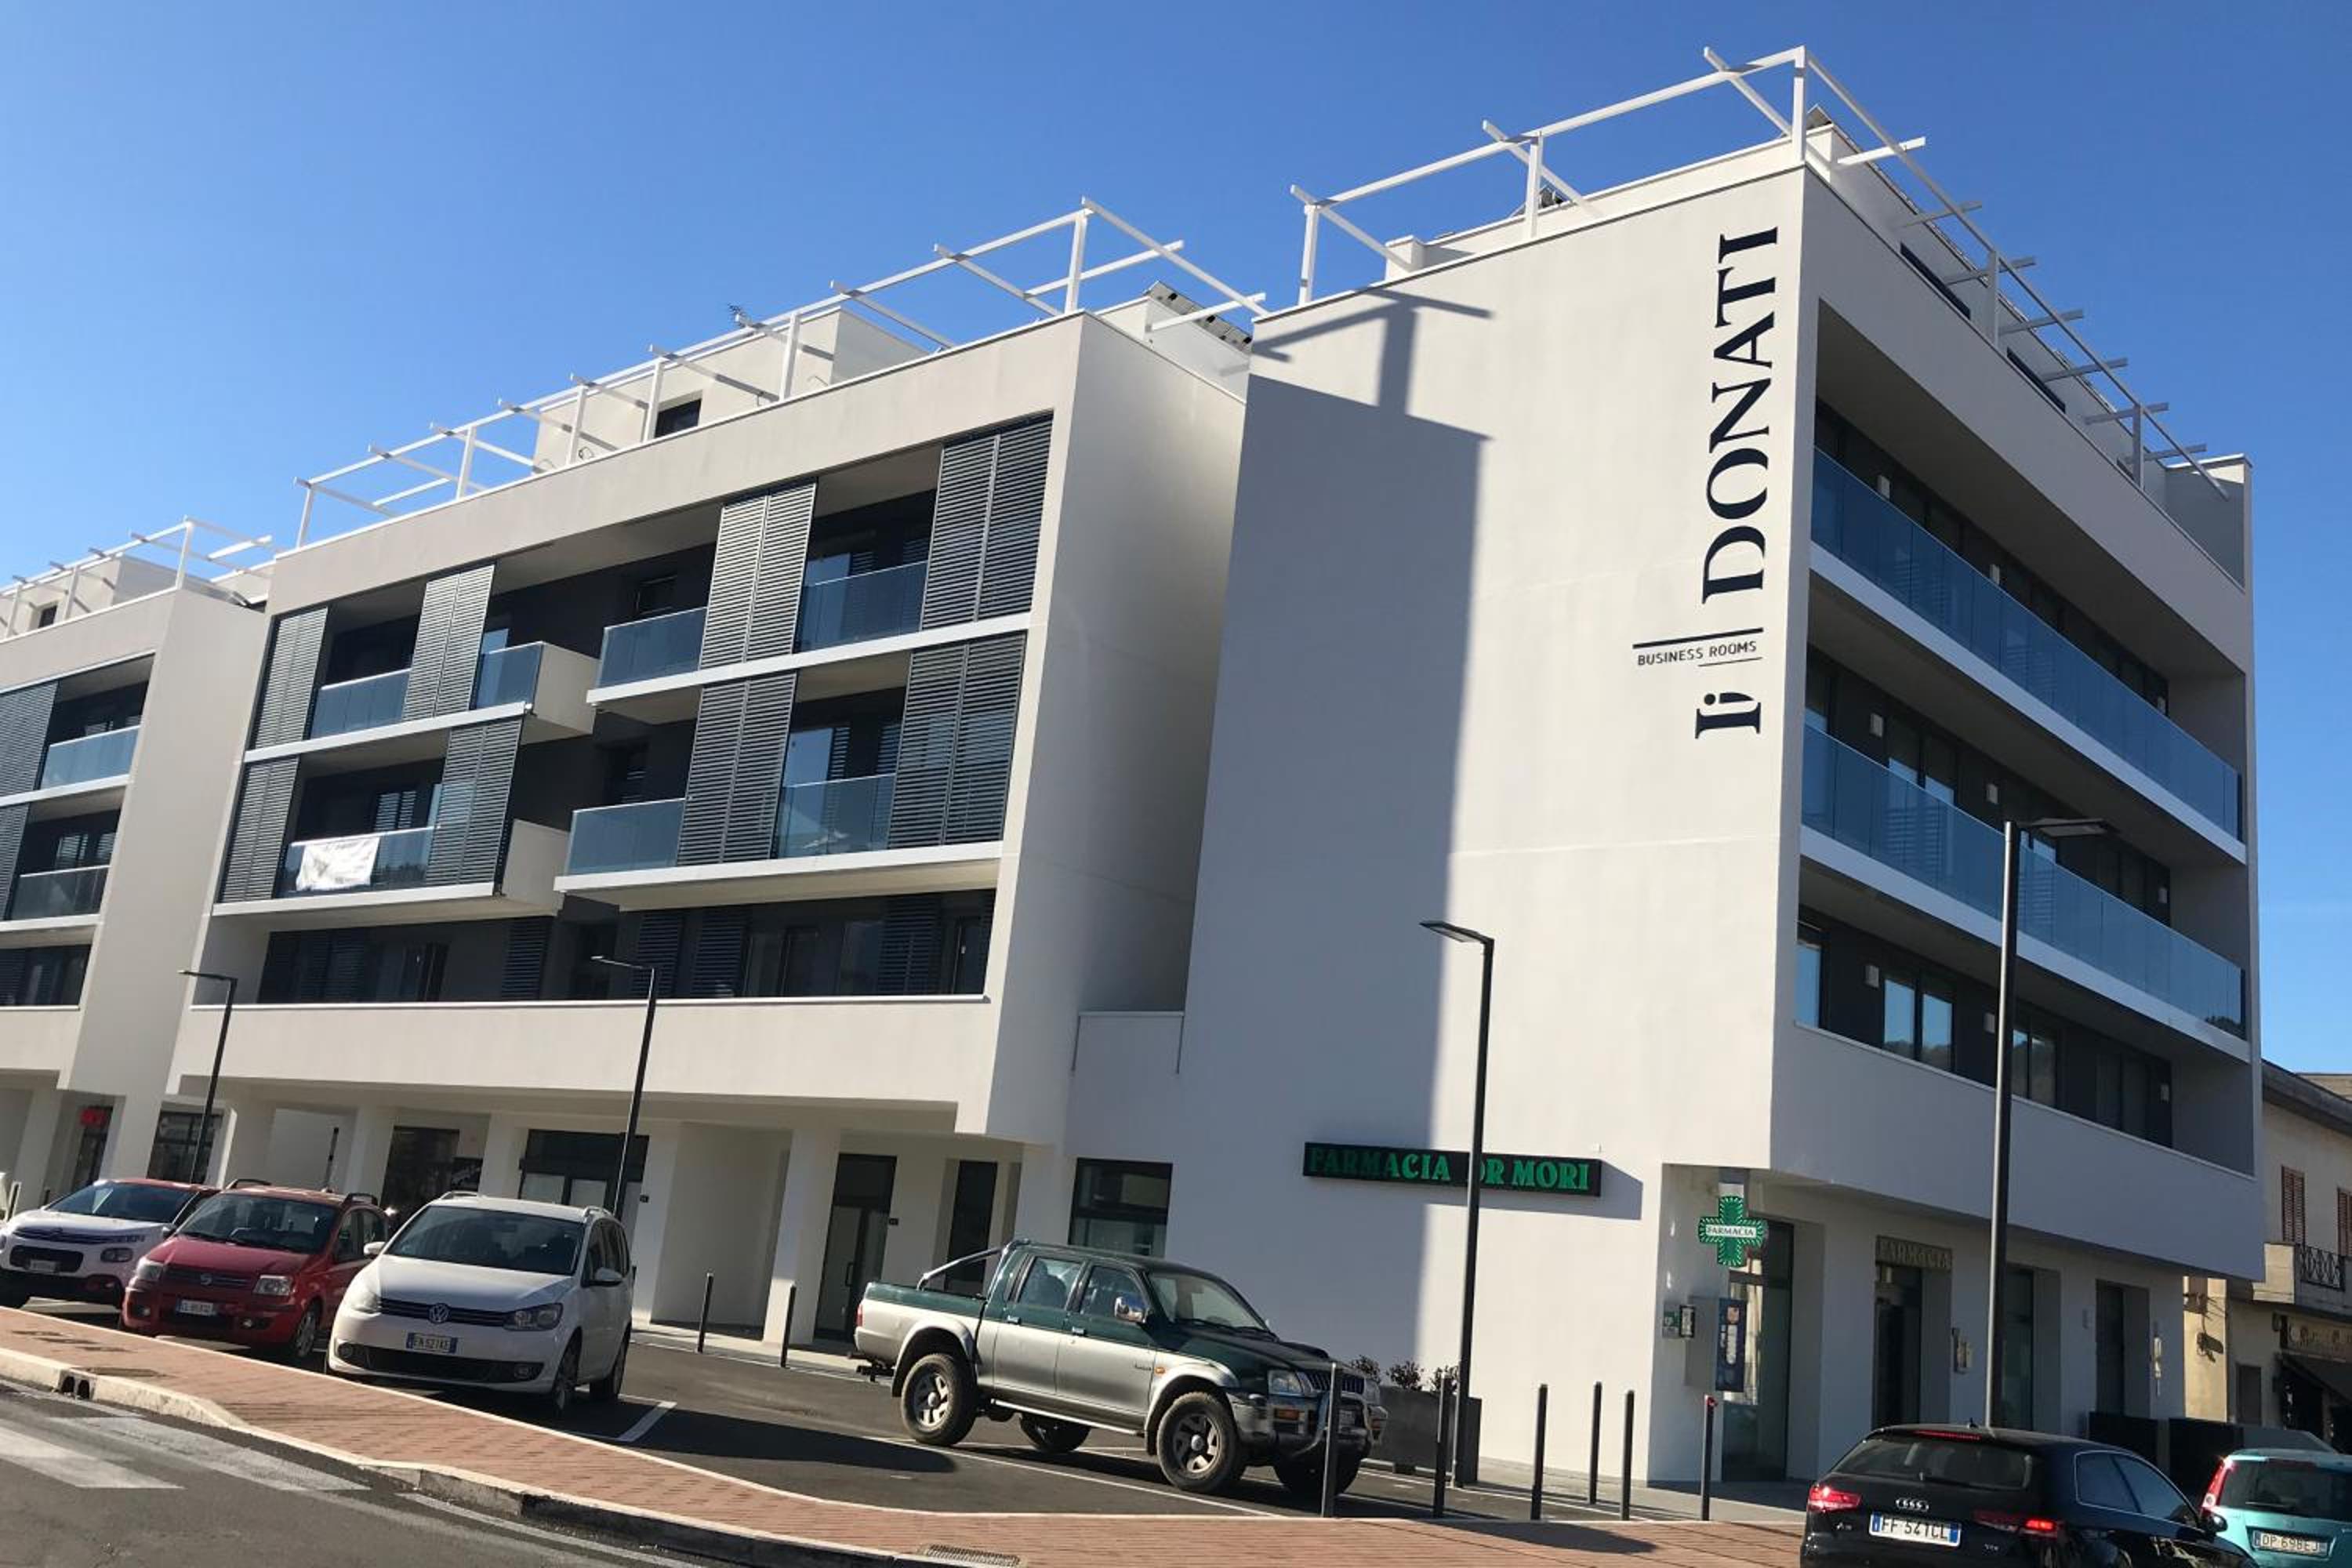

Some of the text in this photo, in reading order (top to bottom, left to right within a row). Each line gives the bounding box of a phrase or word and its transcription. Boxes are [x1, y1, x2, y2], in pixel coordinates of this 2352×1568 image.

[1702, 226, 1778, 604] DONATI
[1638, 641, 1757, 666] BUSINESS ROOMS
[1309, 1148, 1451, 1181] FARMACIA
[1512, 1160, 1589, 1191] MORI
[1708, 1225, 1754, 1236] FARMACIA
